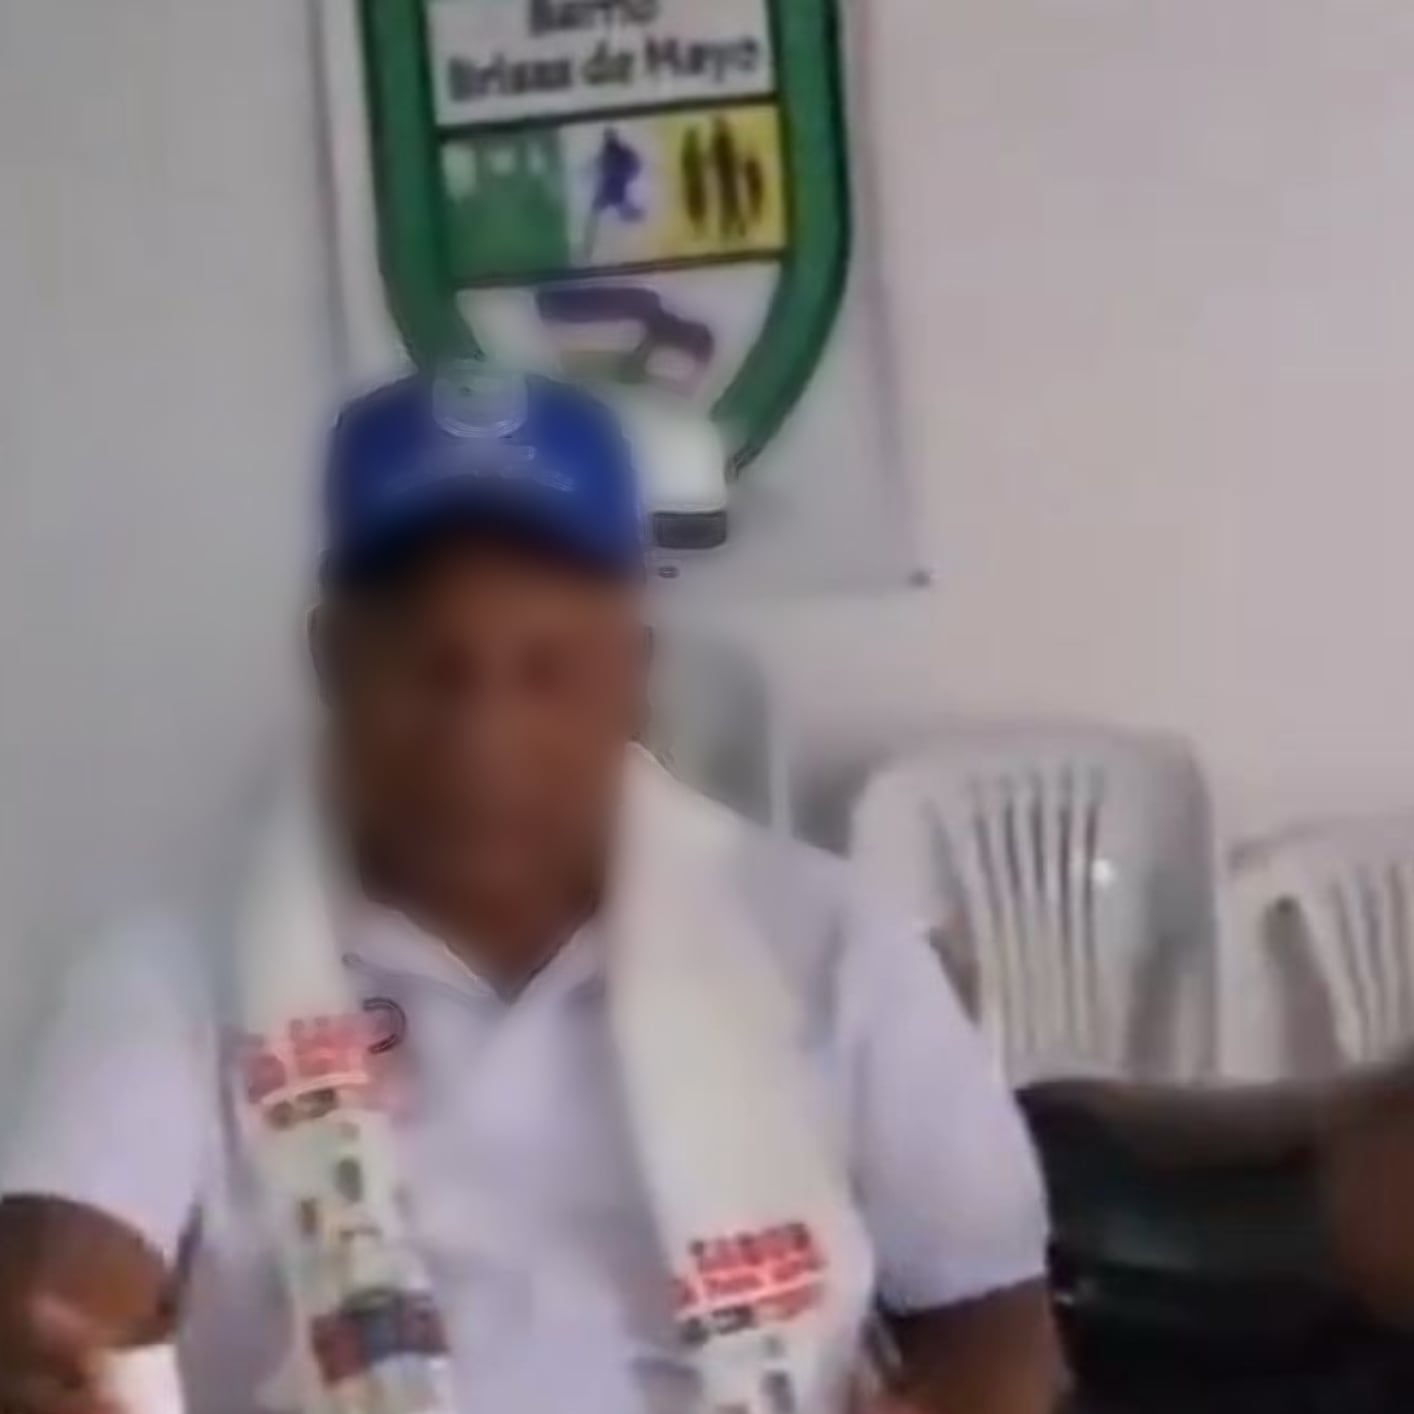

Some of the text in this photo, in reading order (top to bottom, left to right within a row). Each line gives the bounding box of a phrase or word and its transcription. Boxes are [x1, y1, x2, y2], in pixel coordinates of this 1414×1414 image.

[447, 36, 760, 101] Brisas de Mayo
